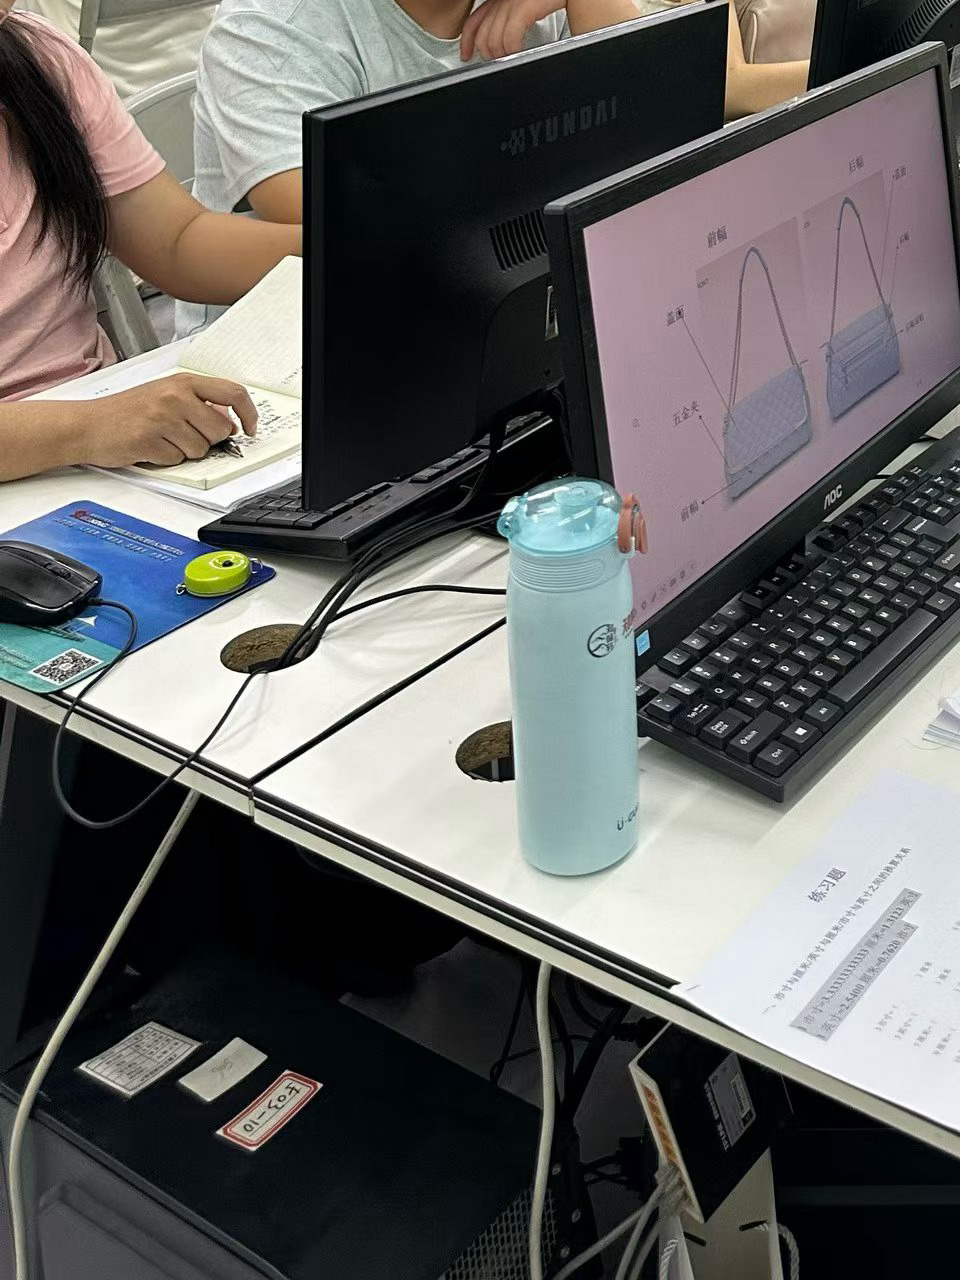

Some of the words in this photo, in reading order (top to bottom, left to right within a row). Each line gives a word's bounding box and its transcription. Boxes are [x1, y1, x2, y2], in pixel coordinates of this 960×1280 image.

[503, 96, 617, 156] HYUNDAI
[707, 225, 727, 248] 前幅
[823, 484, 843, 510] AOC
[808, 864, 846, 905] 练习题
